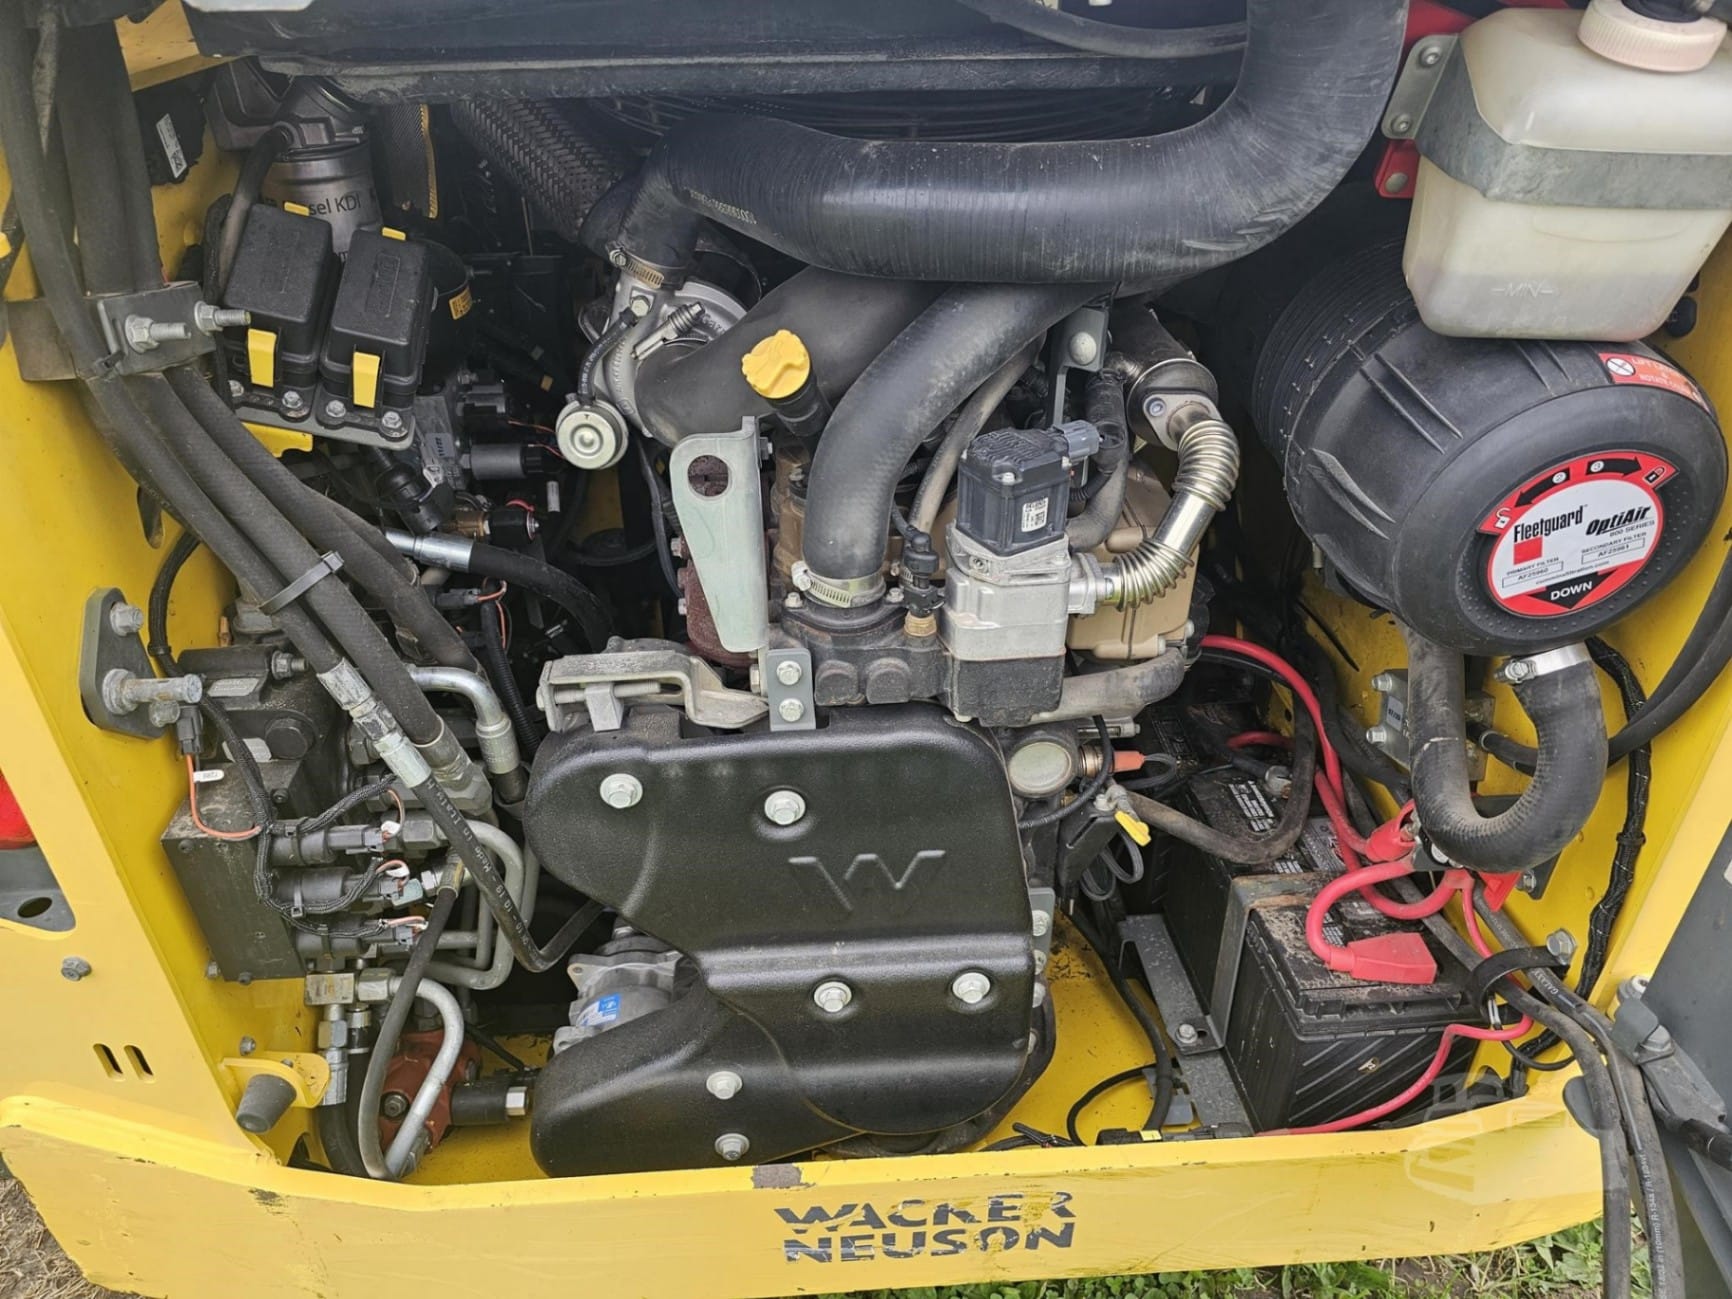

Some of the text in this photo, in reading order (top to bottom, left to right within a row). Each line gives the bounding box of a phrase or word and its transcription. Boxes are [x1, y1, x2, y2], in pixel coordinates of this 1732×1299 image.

[335, 193, 361, 213] KDI
[1513, 505, 1583, 543] Fleetguard
[1586, 506, 1651, 536] OptiAir
[1623, 532, 1647, 541] FILTER
[1536, 557, 1560, 567] FILTER
[1550, 581, 1593, 601] DOWN
[437, 790, 462, 826] Italy
[463, 827, 474, 842] in
[474, 846, 492, 873] Made
[774, 1190, 1077, 1234] WACKER
[783, 1221, 1076, 1263] NEUSON
